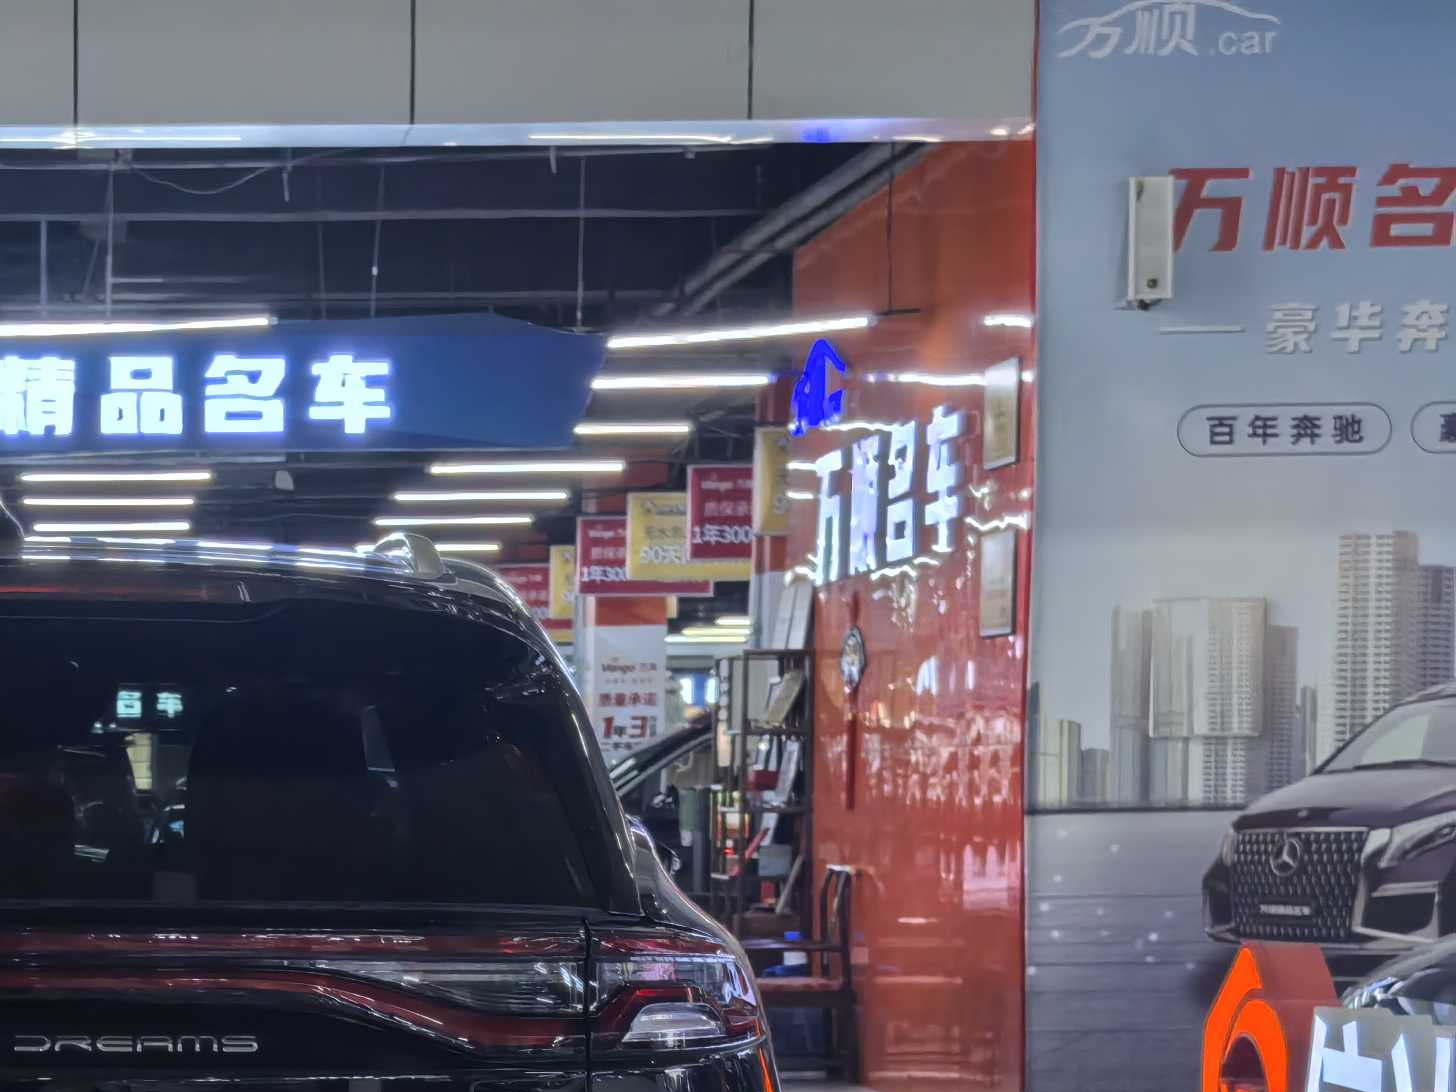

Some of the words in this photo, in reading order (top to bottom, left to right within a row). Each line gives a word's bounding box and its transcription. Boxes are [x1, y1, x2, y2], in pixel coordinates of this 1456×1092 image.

[1264, 301, 1449, 354] 豪华奔
[1206, 414, 1365, 446] 百年奔驰
[13, 1033, 259, 1052] DREAMS
